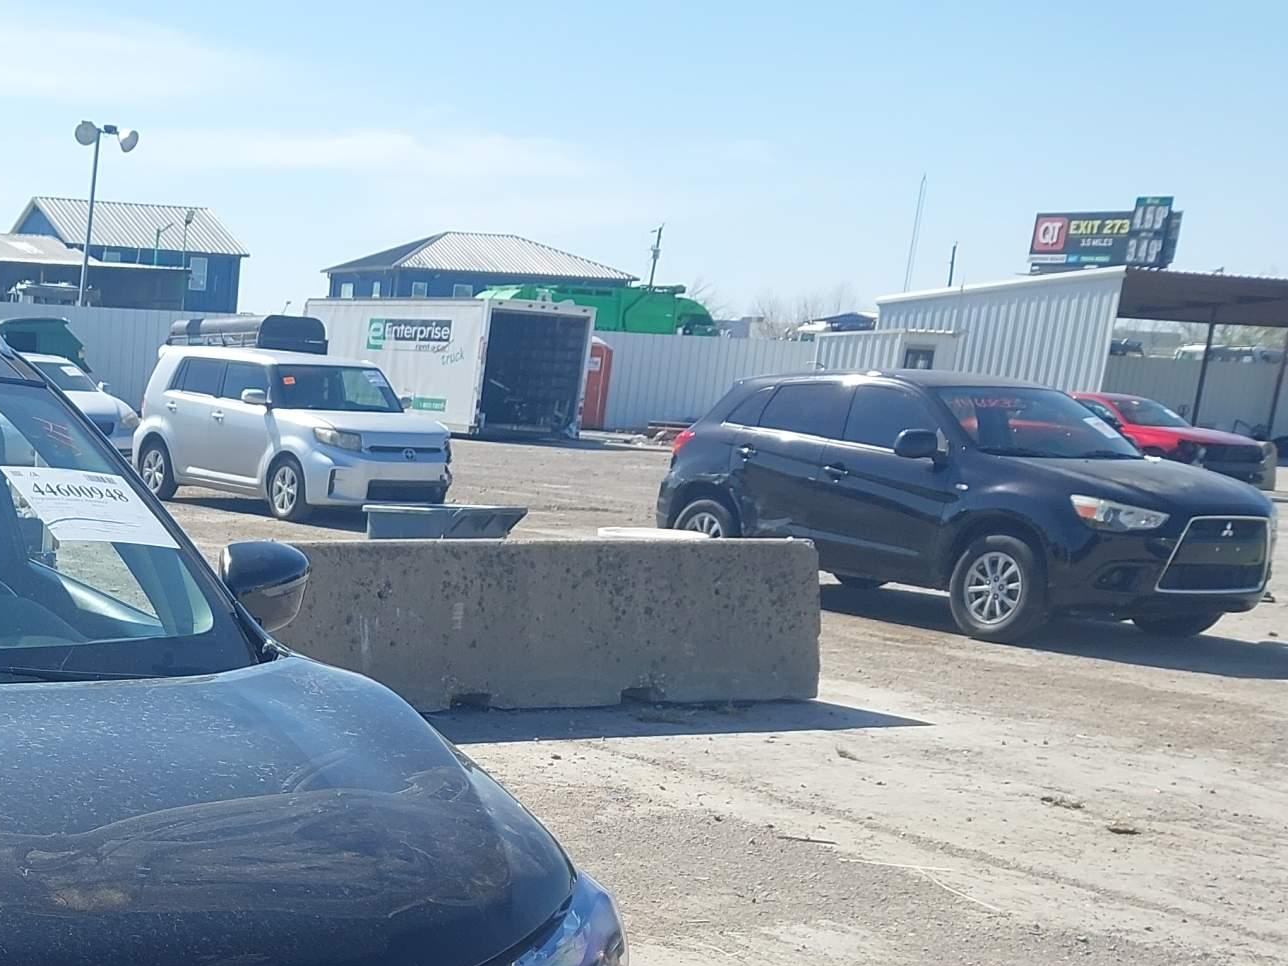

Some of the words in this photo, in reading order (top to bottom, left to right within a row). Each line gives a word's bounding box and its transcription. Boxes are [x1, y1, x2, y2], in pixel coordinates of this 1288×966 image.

[1039, 222, 1063, 245] QT
[1069, 219, 1101, 234] EXIT
[1102, 218, 1130, 234] 273
[1091, 238, 1113, 246] MILES
[385, 321, 450, 342] Enterprise
[415, 343, 430, 351] rent
[441, 347, 464, 366] truck
[33, 482, 129, 503] 44600948
